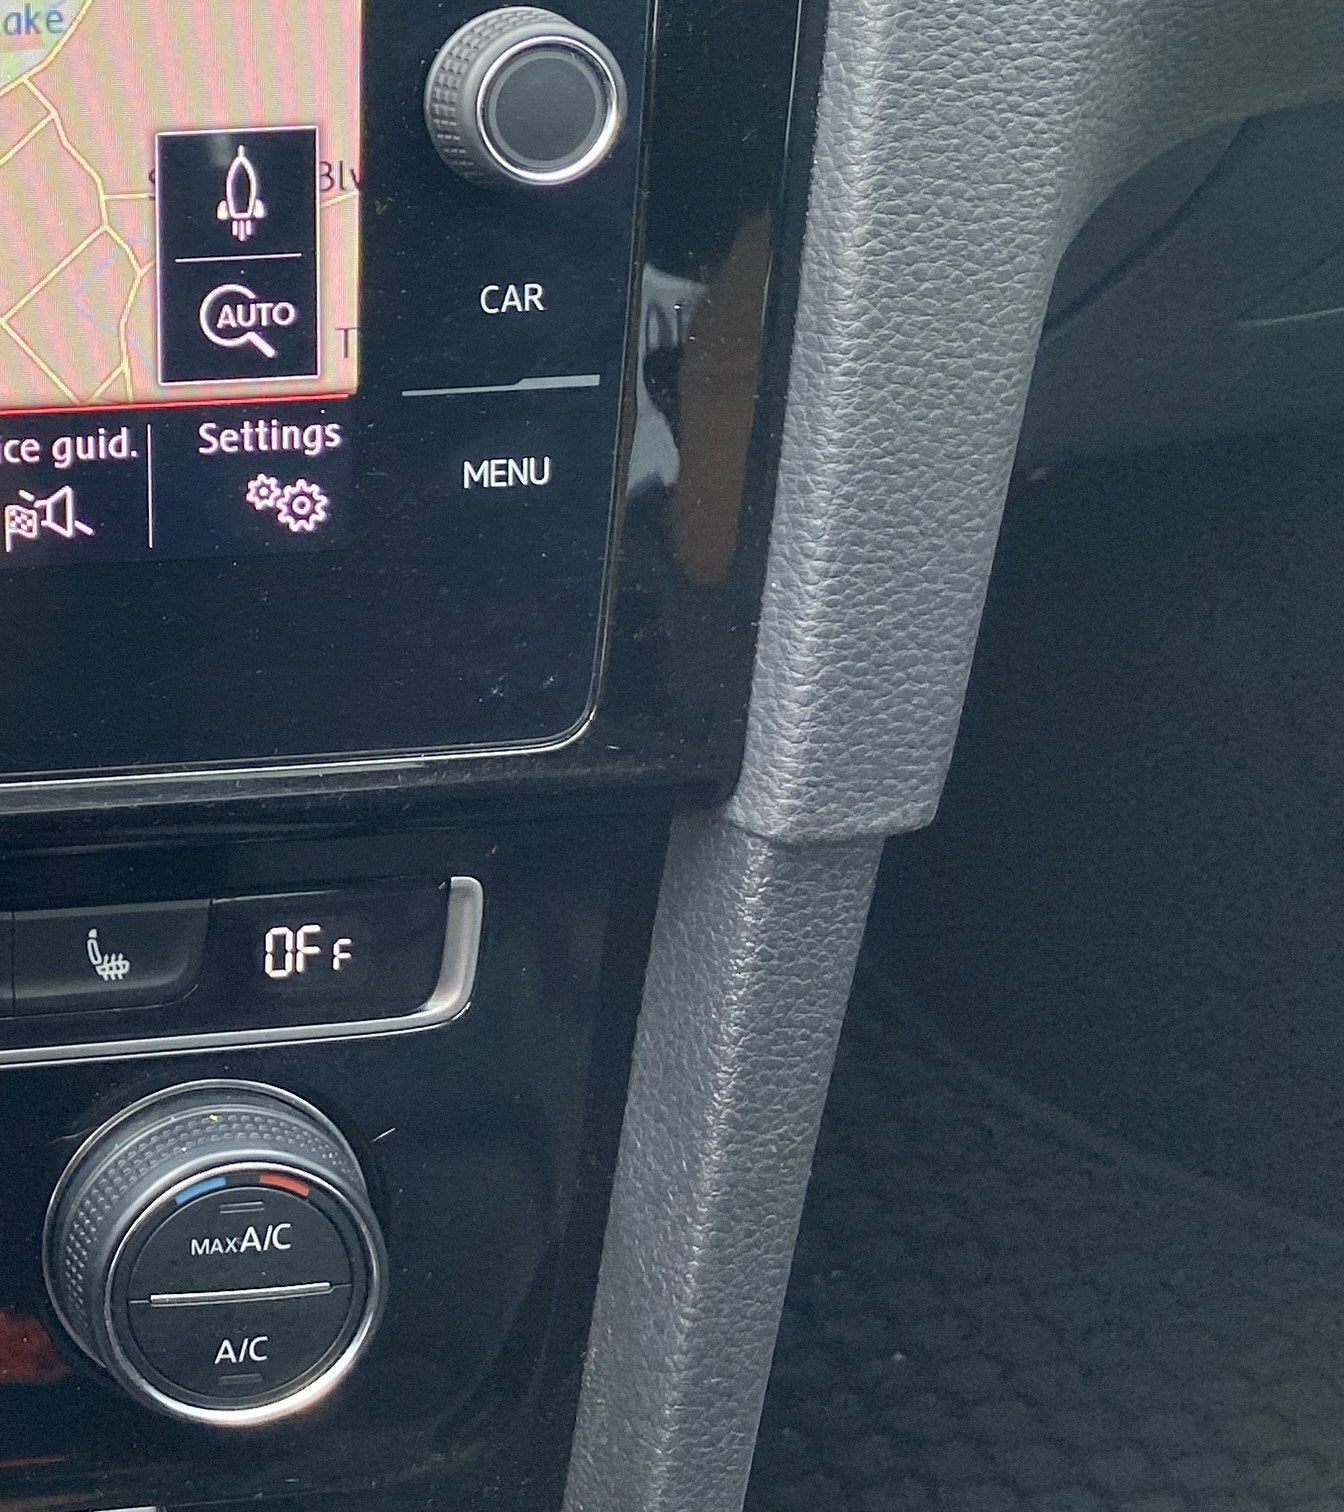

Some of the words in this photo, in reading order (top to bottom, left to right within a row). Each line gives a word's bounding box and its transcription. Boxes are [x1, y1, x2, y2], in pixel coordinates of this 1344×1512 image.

[480, 283, 544, 314] CAR
[216, 302, 296, 329] AUTO
[51, 427, 138, 469] guid.
[198, 420, 341, 458] Settings
[463, 456, 551, 489] MENU
[214, 1336, 269, 1365] A/C
